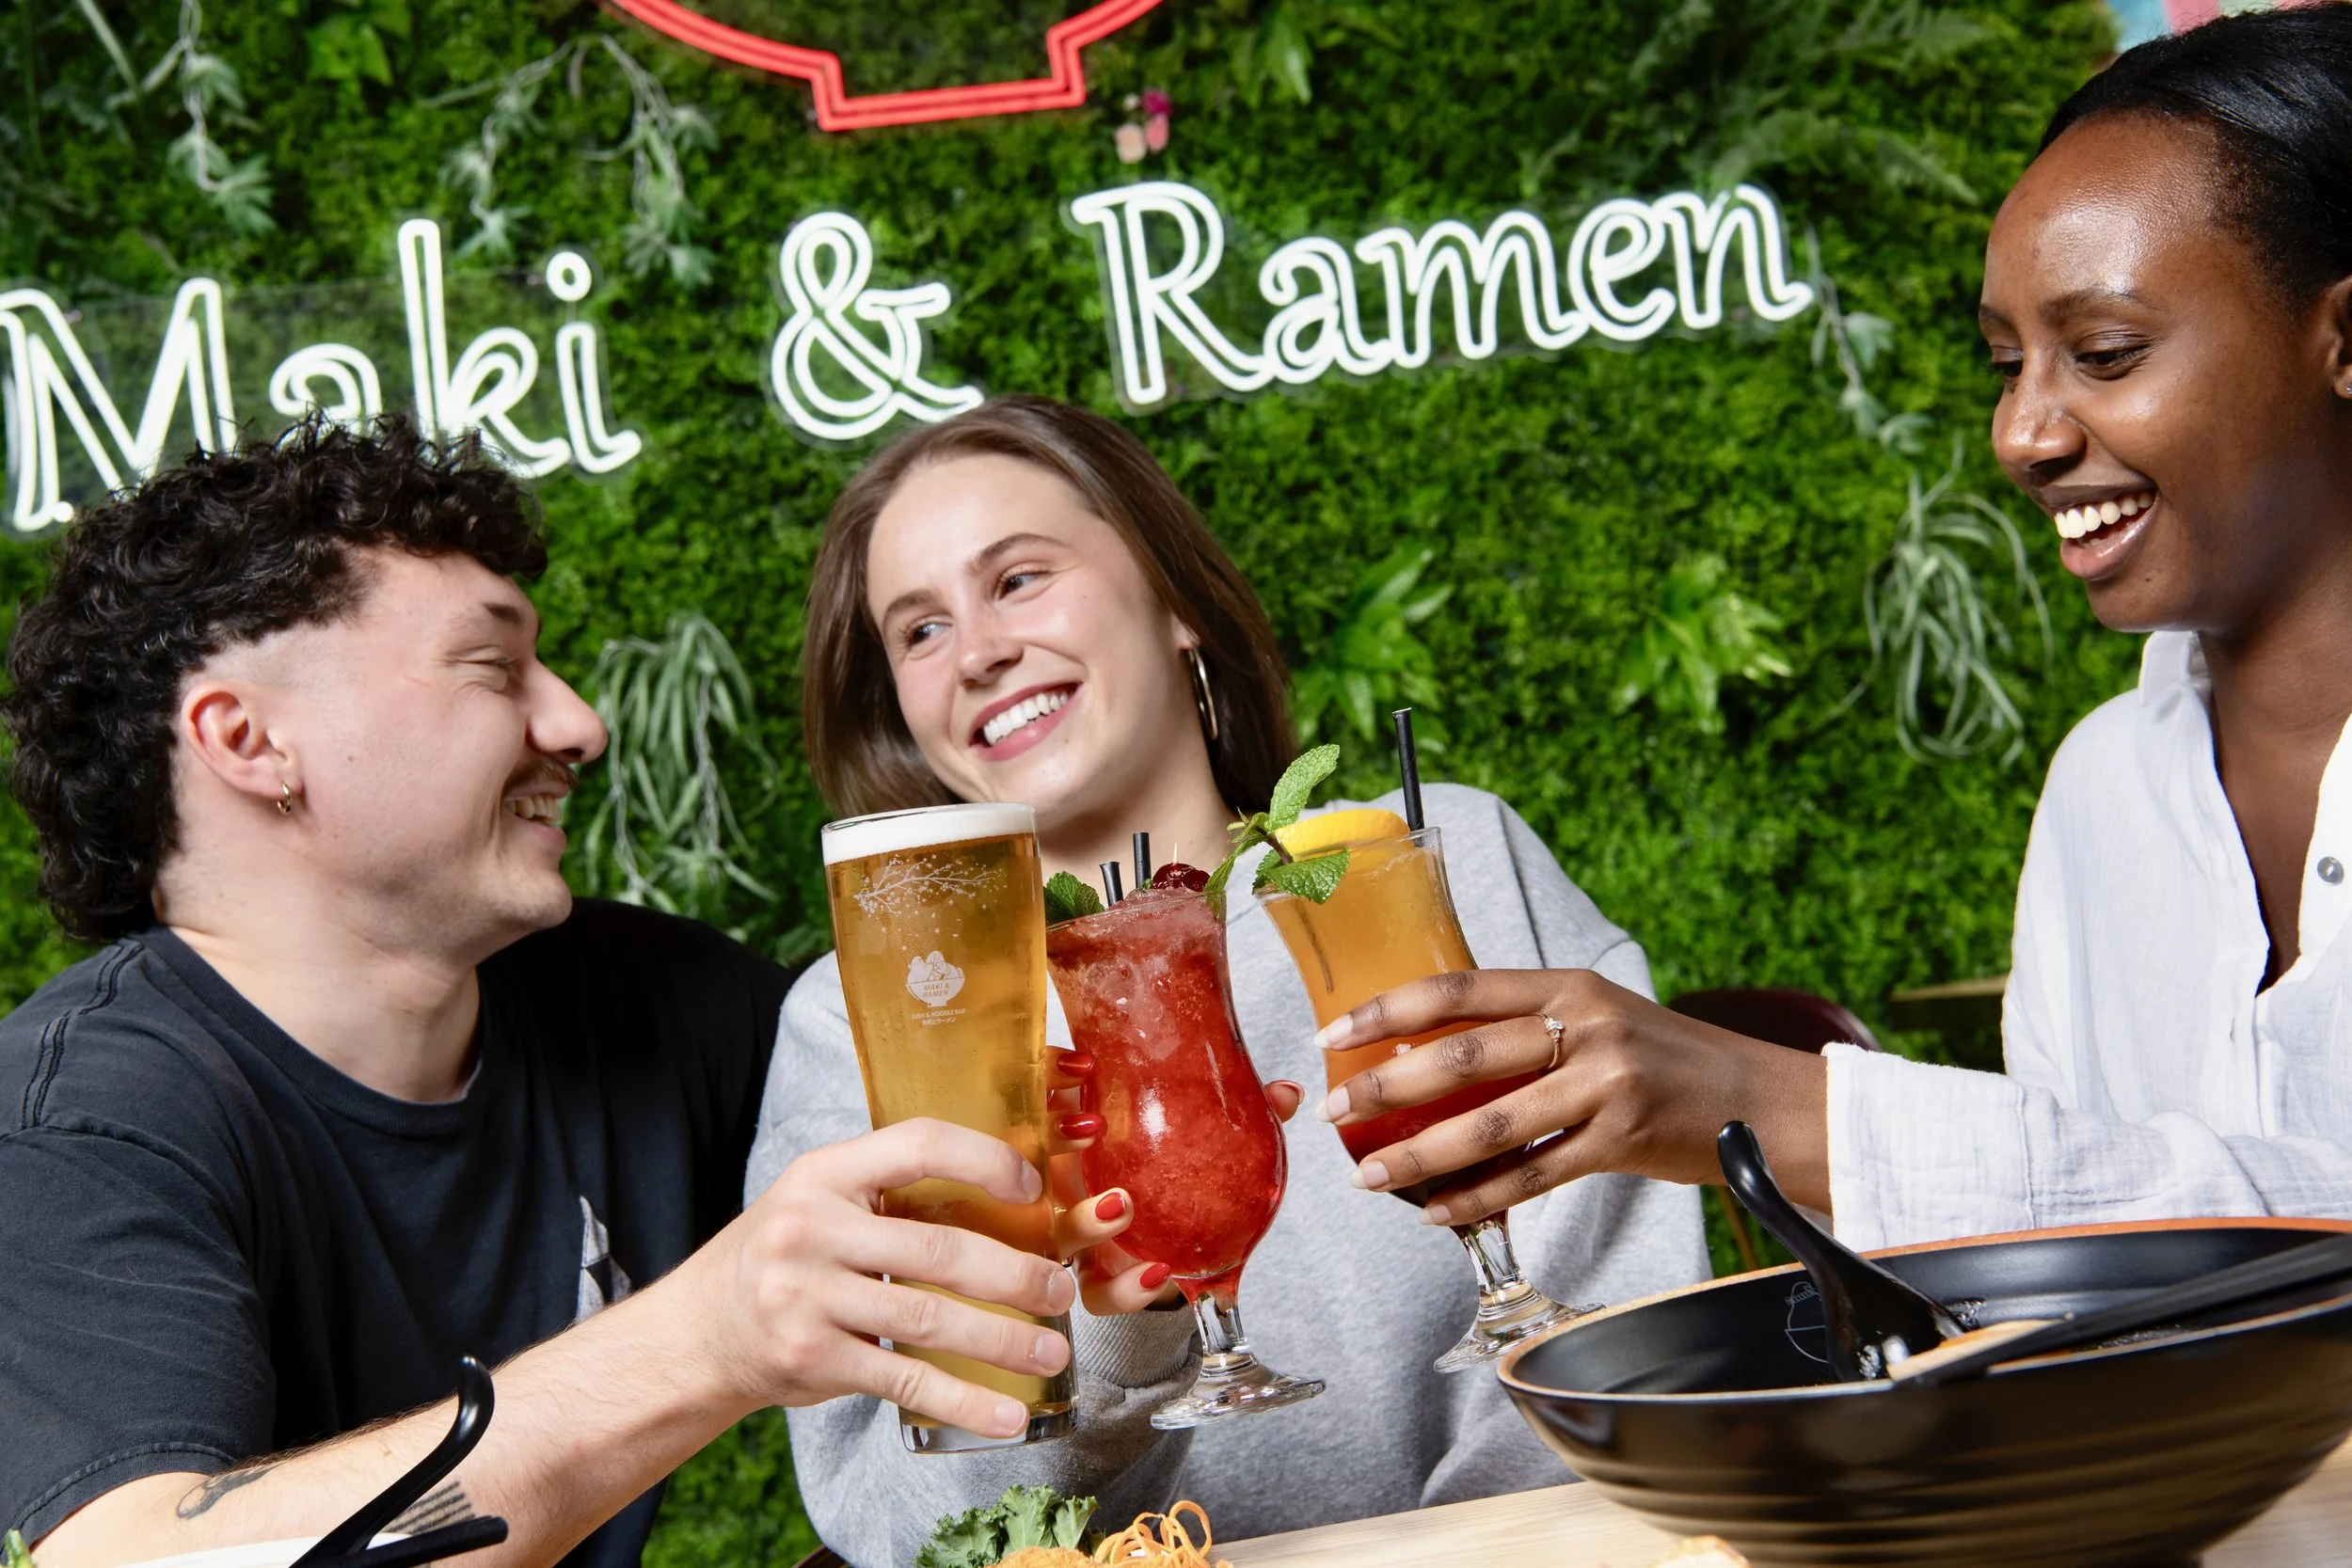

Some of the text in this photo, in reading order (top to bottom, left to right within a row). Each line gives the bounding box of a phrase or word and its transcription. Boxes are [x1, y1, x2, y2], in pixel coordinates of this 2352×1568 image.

[0, 182, 1816, 531] Maki & Ramen
[923, 990, 949, 998] RAMEN
